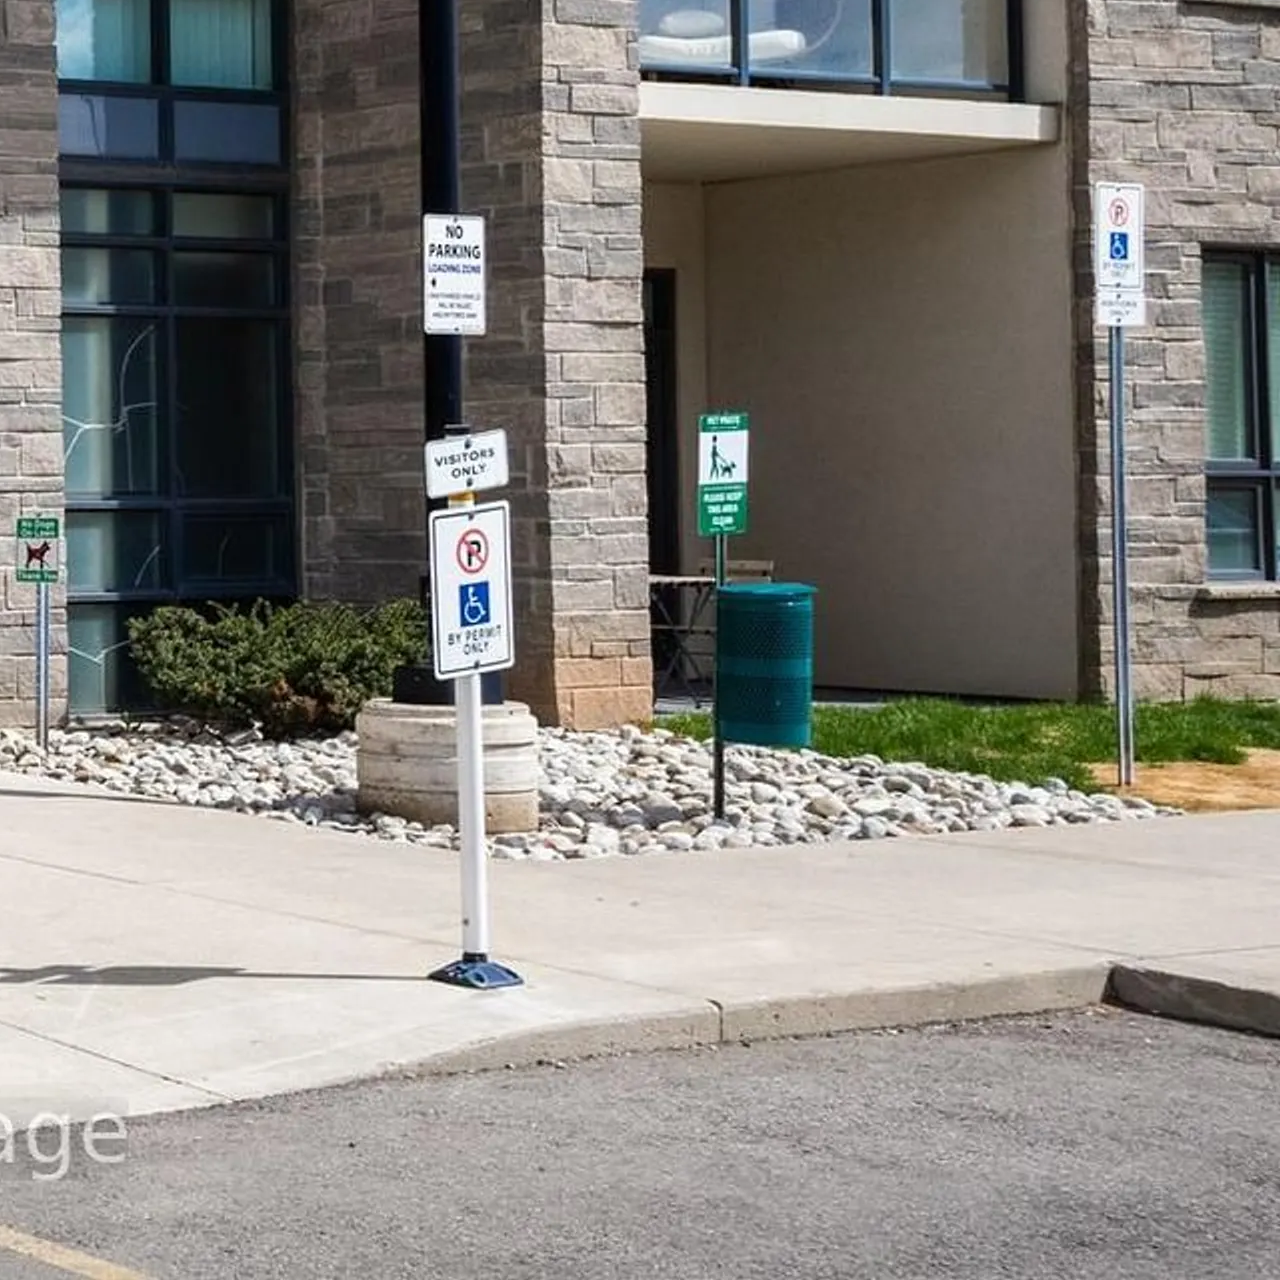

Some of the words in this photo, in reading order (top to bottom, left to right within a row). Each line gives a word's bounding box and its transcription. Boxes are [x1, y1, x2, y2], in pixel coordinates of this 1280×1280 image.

[445, 224, 464, 239] NO
[428, 243, 481, 259] PARKING
[434, 447, 496, 467] VISITORS
[451, 462, 487, 480] ONLY
[448, 633, 461, 646] BY
[465, 625, 502, 642] PERMIT
[463, 642, 489, 656] ONLY
